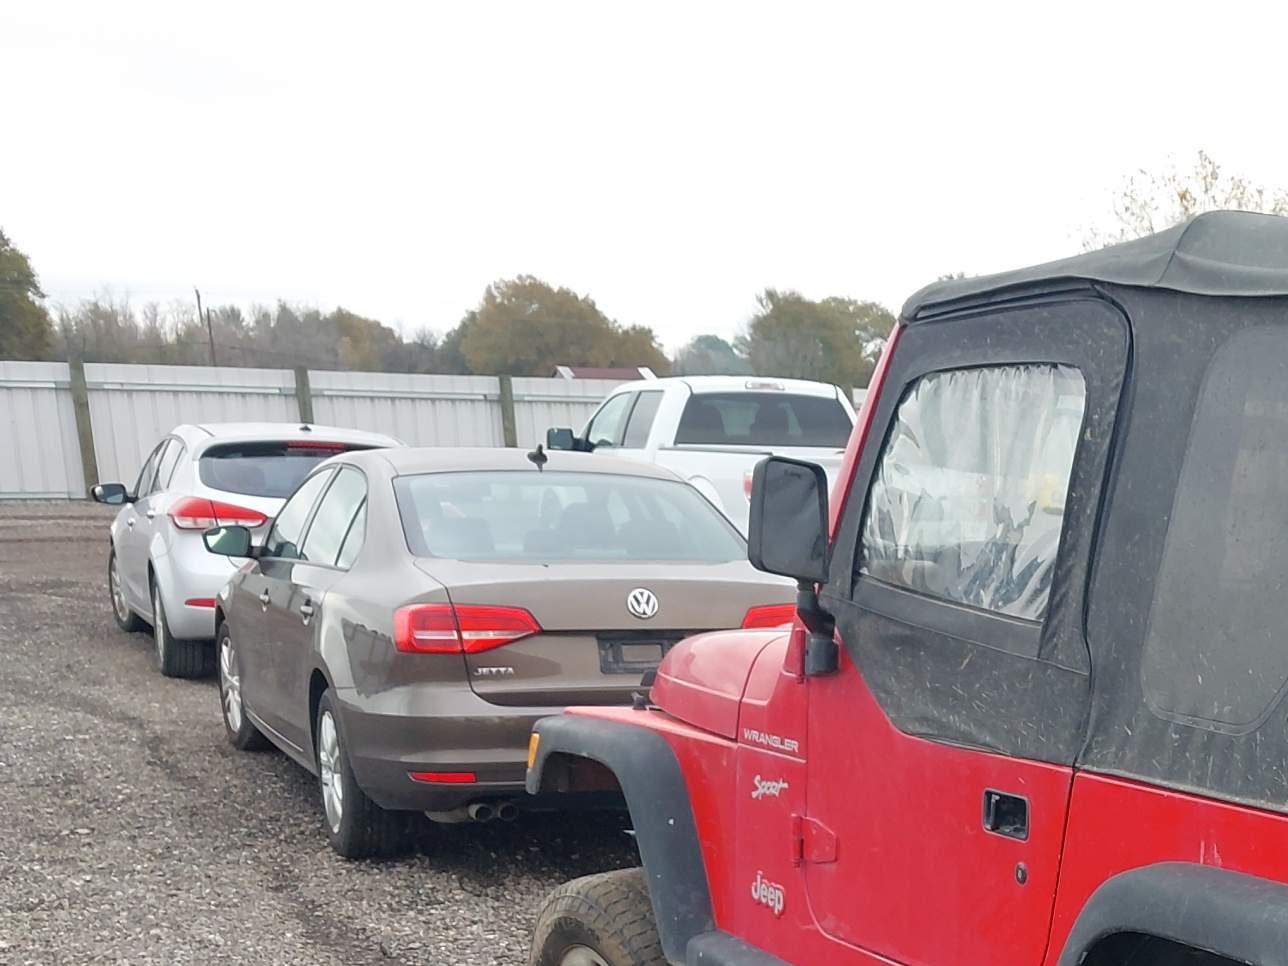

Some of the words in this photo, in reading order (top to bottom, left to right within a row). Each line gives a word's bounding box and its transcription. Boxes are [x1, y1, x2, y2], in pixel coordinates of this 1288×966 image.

[473, 667, 515, 676] JETTA
[743, 728, 799, 752] WRANGLER
[752, 870, 784, 916] Jeep
